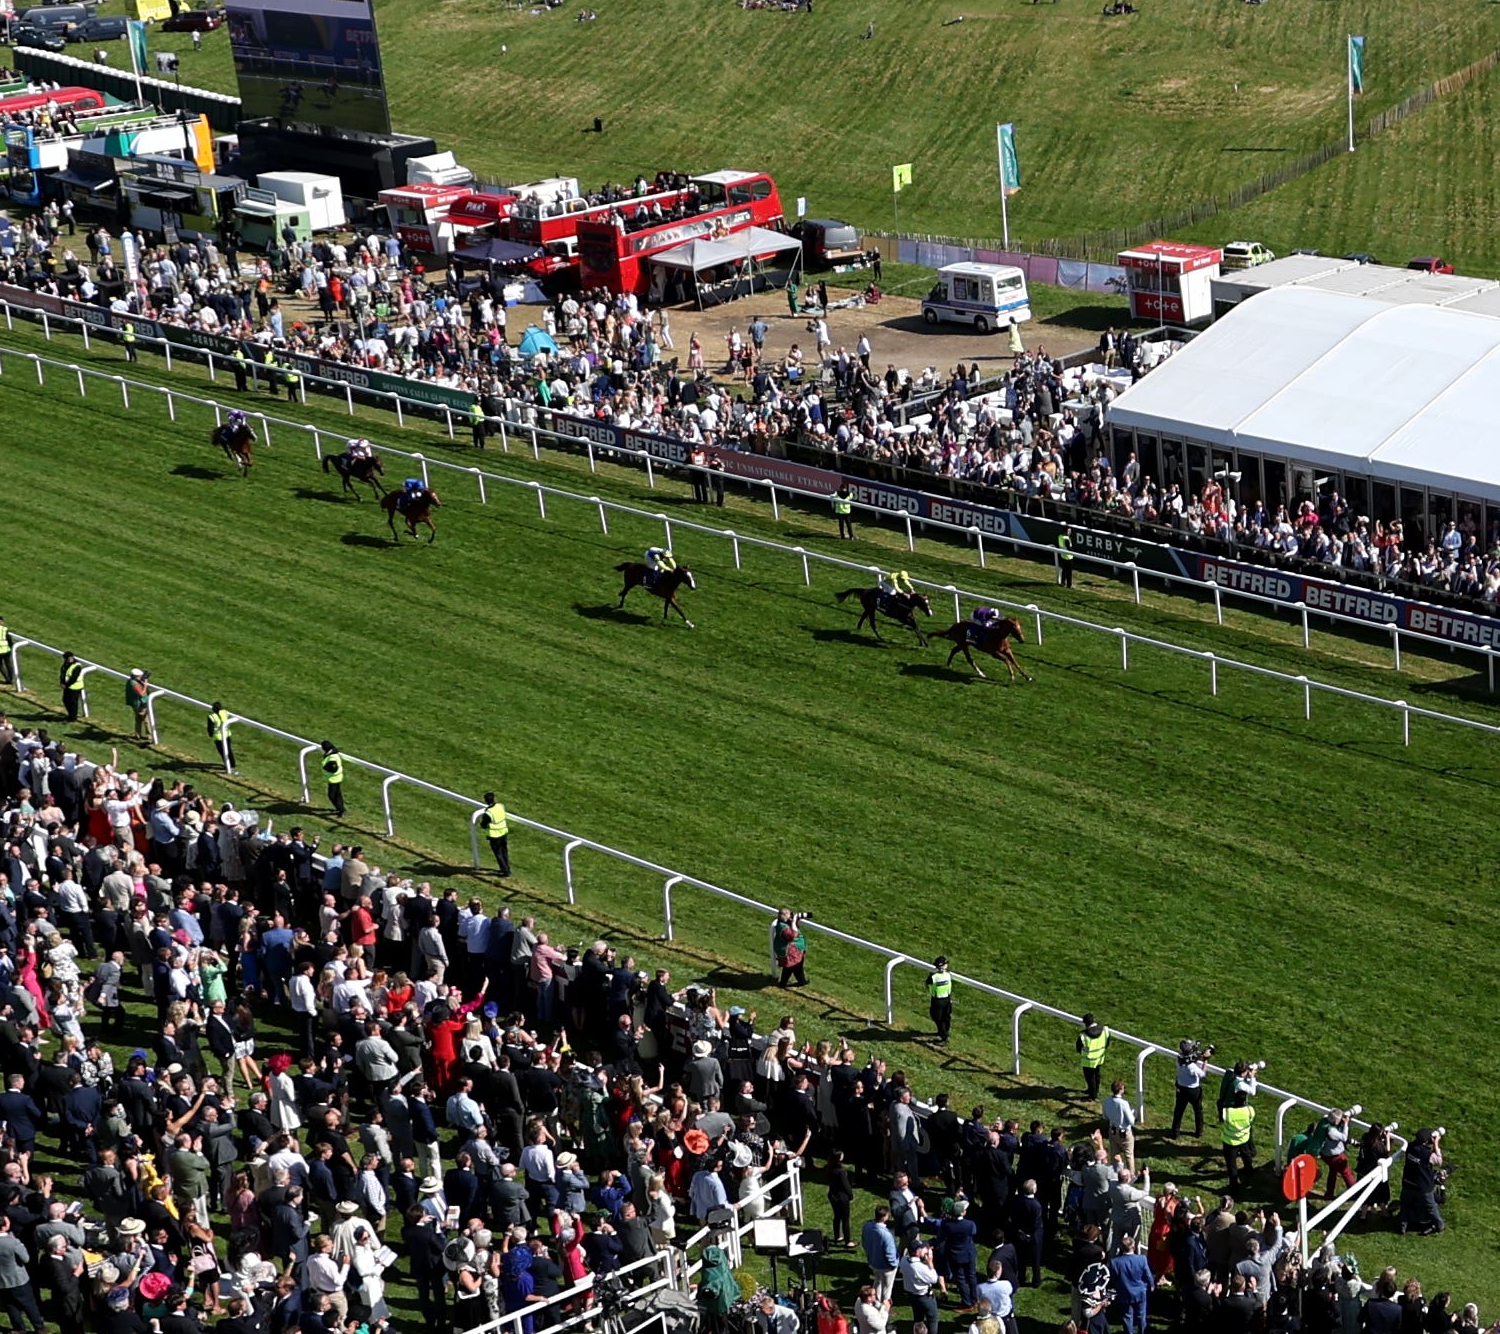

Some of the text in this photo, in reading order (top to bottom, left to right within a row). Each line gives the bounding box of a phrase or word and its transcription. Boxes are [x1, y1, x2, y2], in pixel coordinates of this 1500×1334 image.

[63, 304, 106, 325] BETFRED
[319, 365, 369, 388] BETFRED
[556, 418, 616, 446] BETFRED
[625, 433, 687, 463] BETFRED
[737, 460, 793, 483] UNMATCHABLE
[797, 475, 833, 491] ETERNAL
[847, 483, 919, 515] BETFRED
[931, 503, 1006, 535] BETFRED
[1075, 532, 1123, 554] DERBY
[1203, 564, 1291, 599] BETFRED
[1305, 585, 1398, 622] BETFRED
